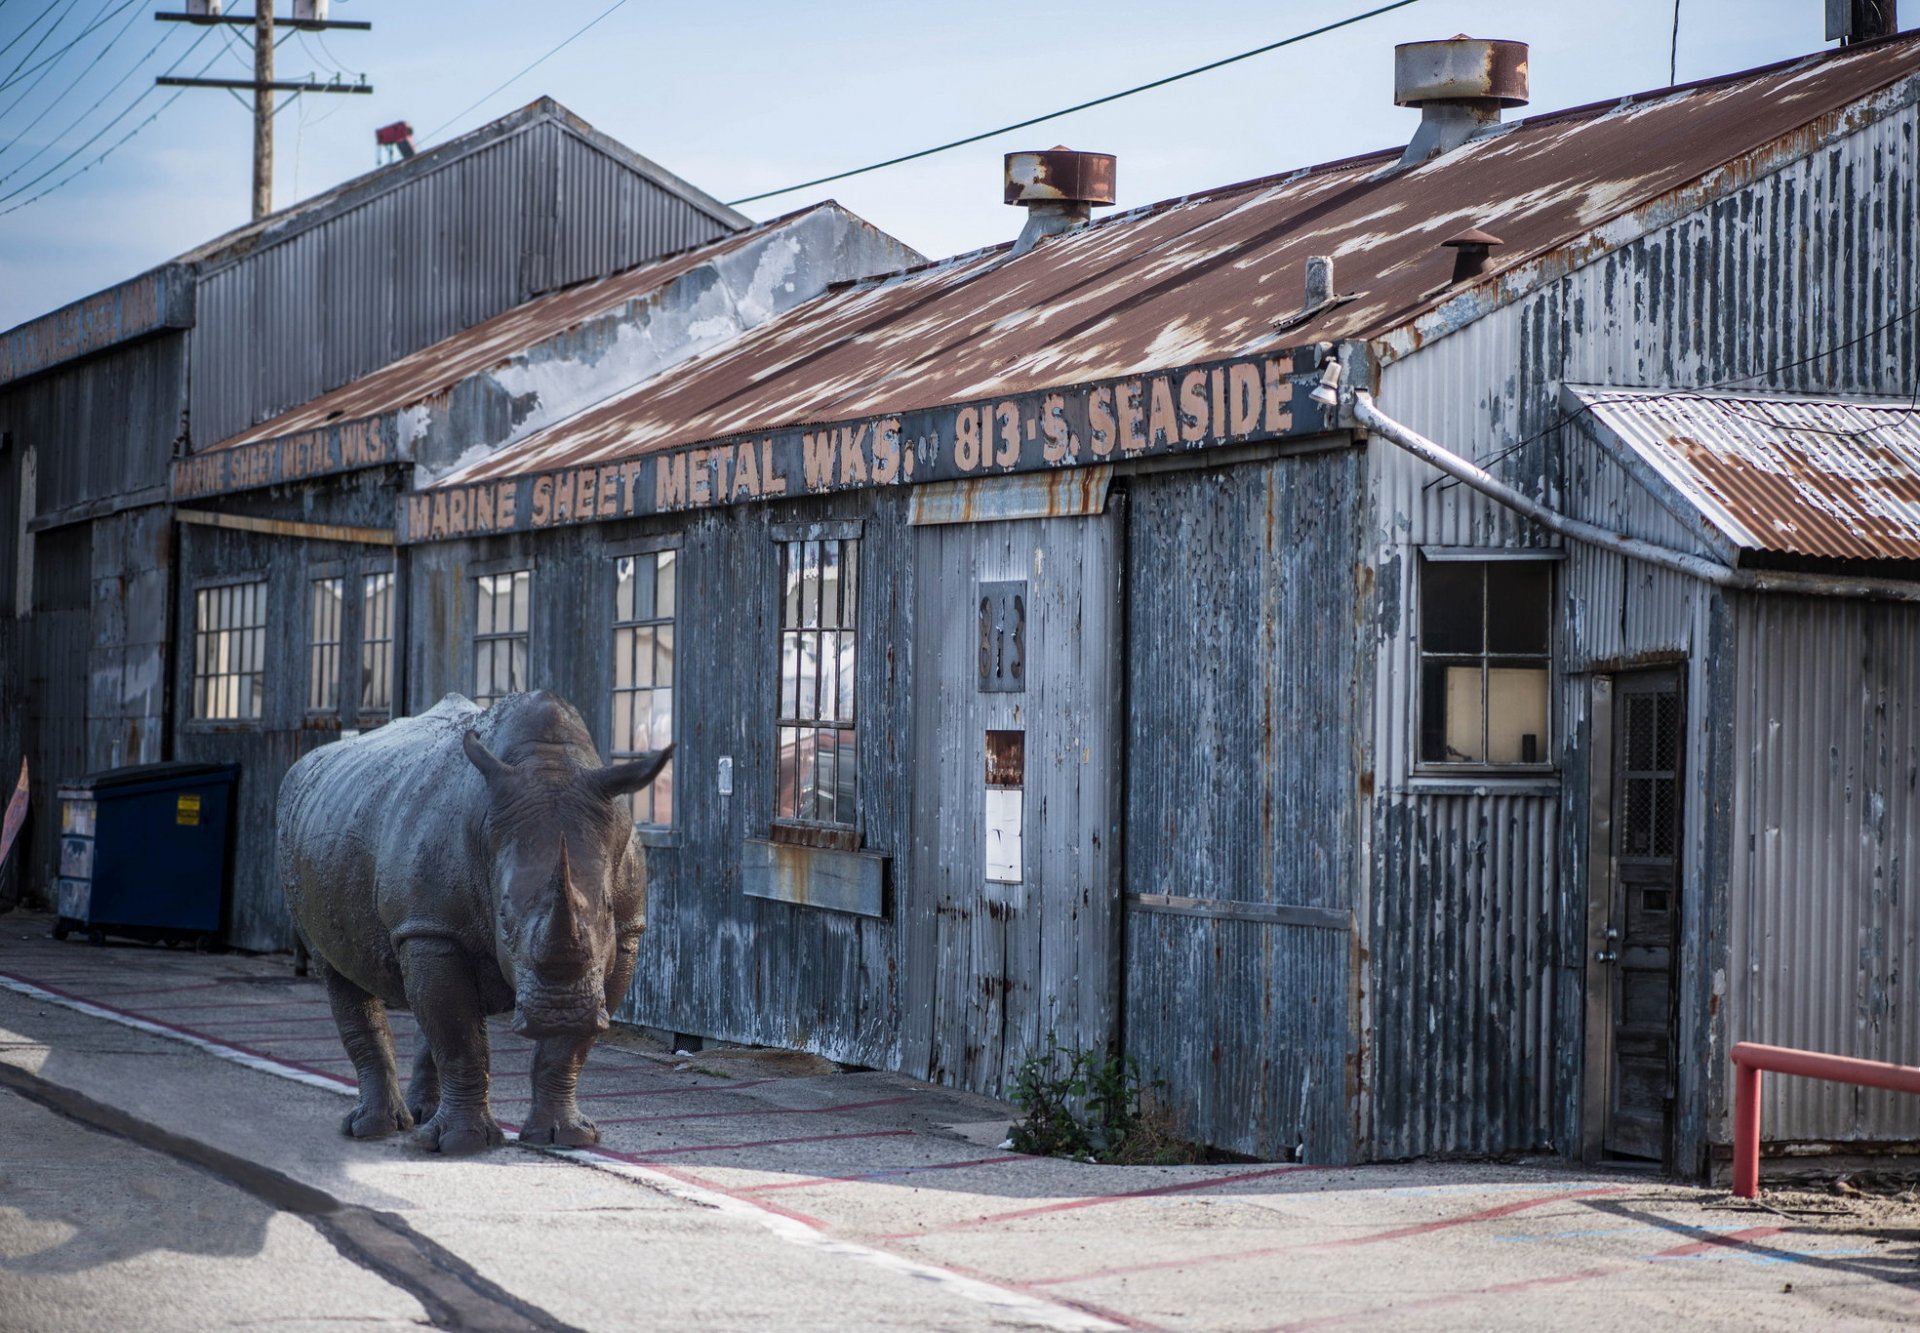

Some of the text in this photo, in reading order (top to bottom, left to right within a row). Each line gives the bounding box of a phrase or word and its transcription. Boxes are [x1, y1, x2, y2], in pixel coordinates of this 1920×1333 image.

[230, 440, 276, 488] SHEET
[282, 430, 334, 477] METAL
[409, 482, 517, 541] MARINE
[530, 460, 641, 525] SHEET
[656, 438, 786, 508] METAL
[803, 418, 914, 489] WKS.
[1089, 357, 1294, 456] SEASIDE
[980, 595, 1025, 678] 813
